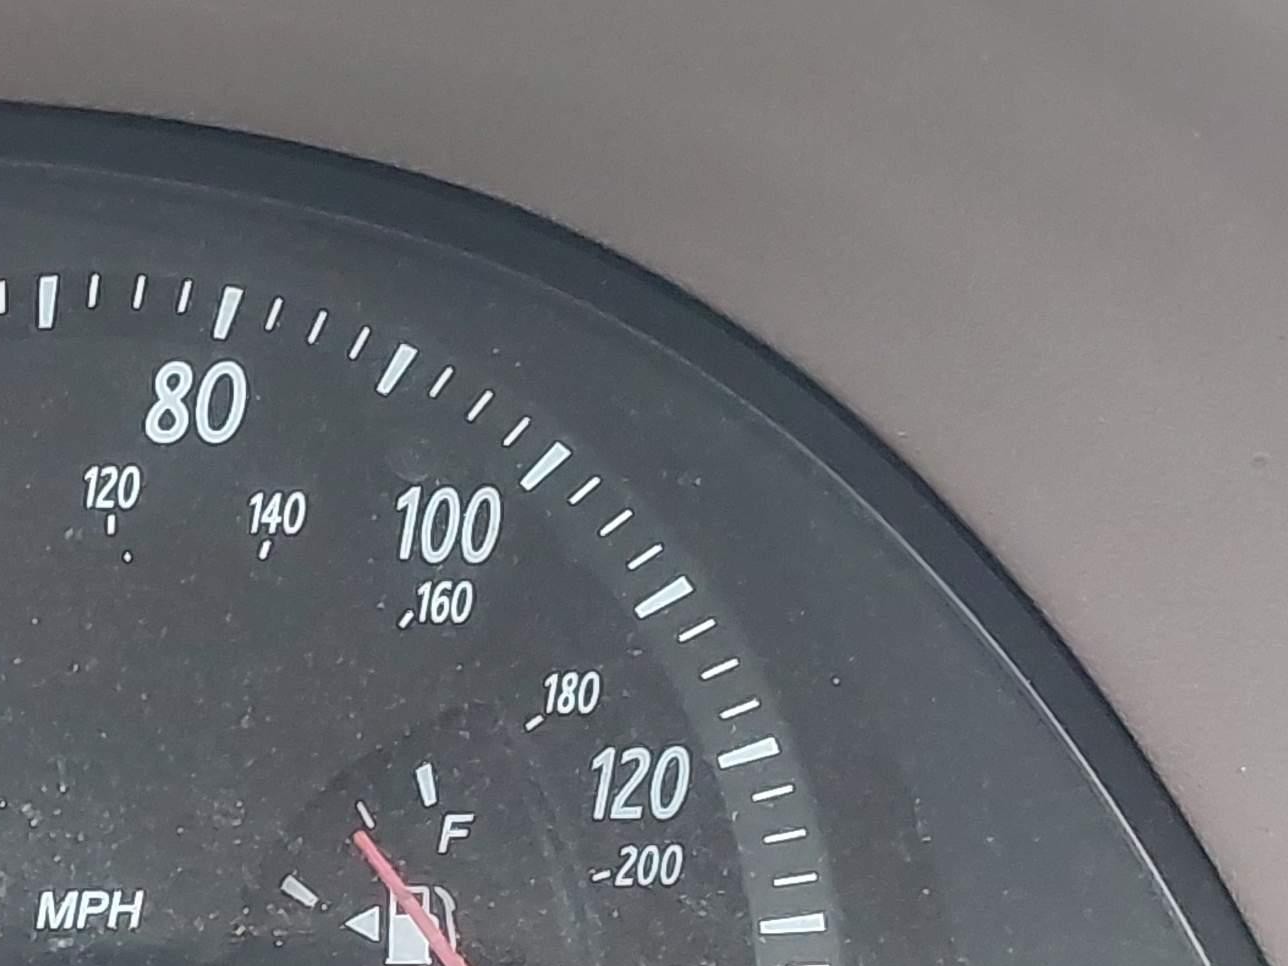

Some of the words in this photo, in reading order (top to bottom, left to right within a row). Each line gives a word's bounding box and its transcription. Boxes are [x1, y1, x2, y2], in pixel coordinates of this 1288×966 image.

[145, 360, 247, 443] 80
[84, 466, 141, 510] 120
[249, 492, 306, 536] 140
[396, 486, 501, 564] 100
[417, 580, 473, 625] 160
[543, 671, 600, 716] 180
[591, 746, 691, 822] 120
[439, 813, 475, 854] F
[615, 845, 683, 887] 200
[36, 889, 143, 930] MPH
